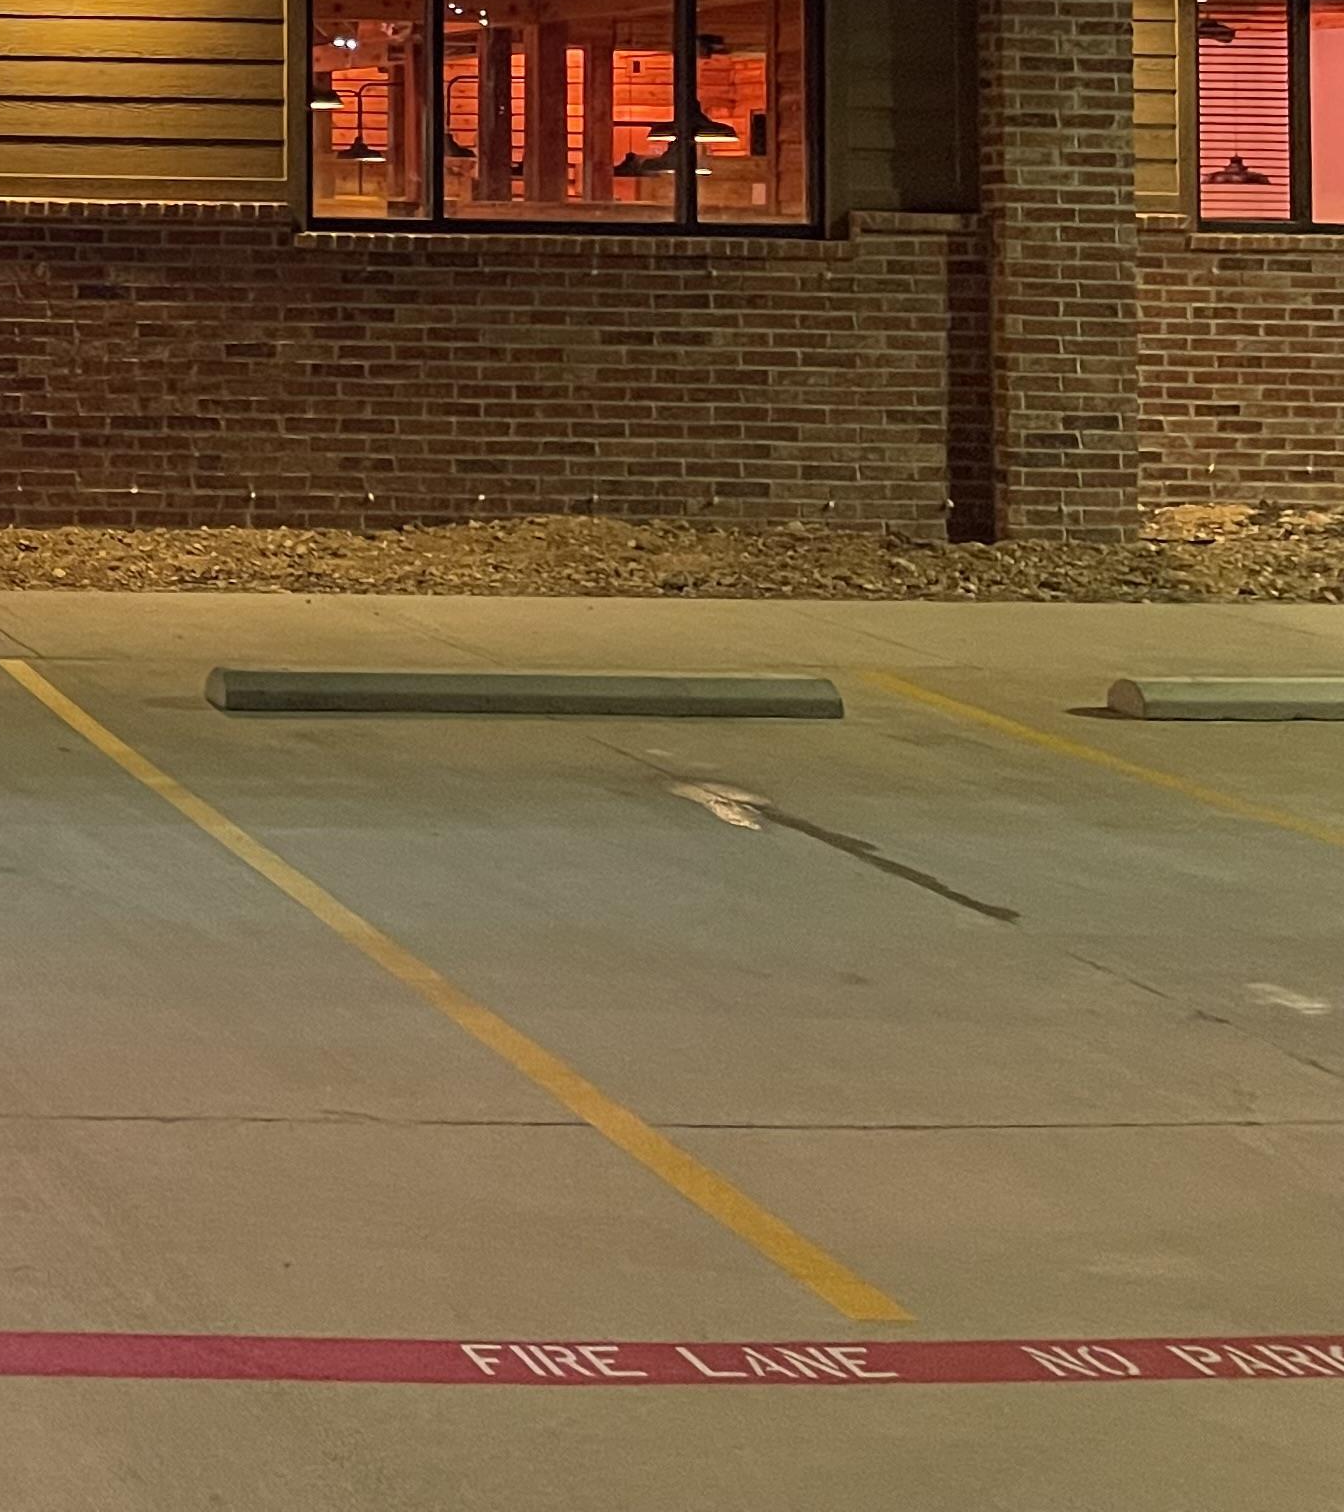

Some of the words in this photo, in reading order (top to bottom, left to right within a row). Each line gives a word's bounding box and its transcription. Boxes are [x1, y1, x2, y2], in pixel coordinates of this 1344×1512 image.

[460, 1344, 648, 1377] FIRE
[675, 1345, 899, 1378] LANE
[1019, 1344, 1141, 1377] NO
